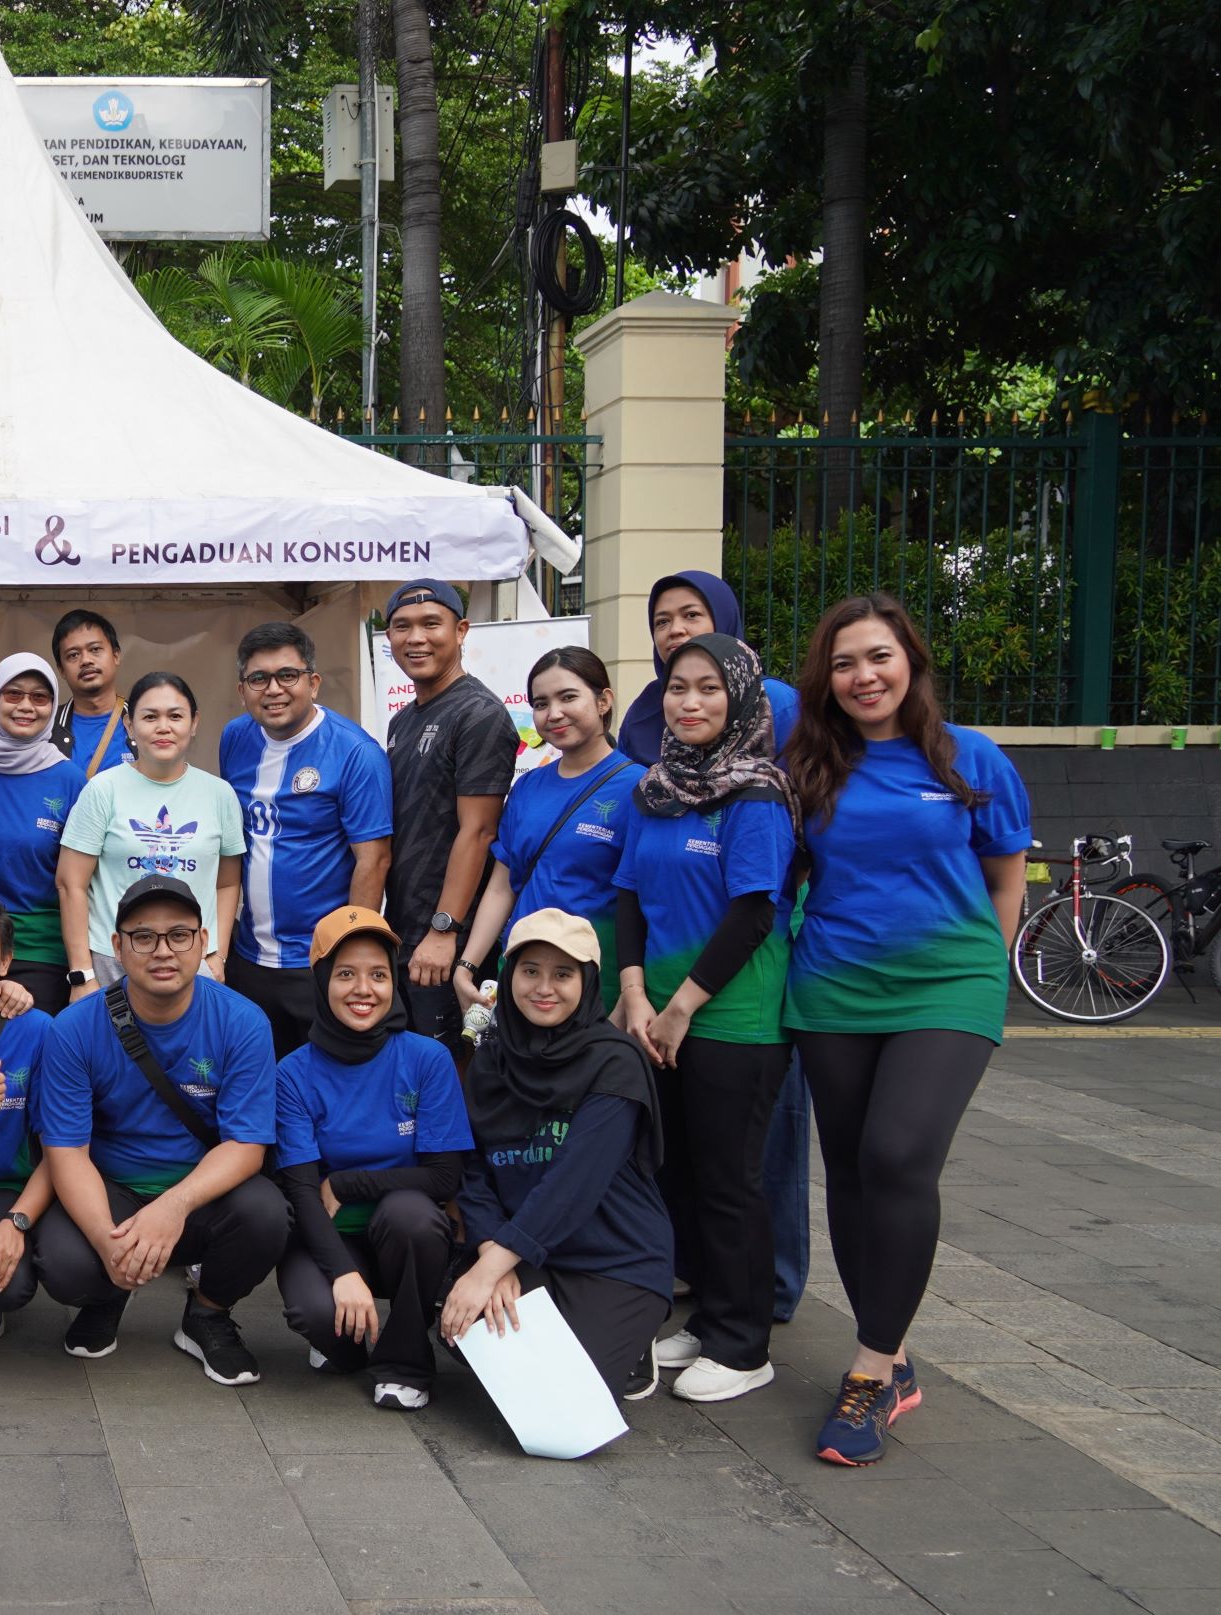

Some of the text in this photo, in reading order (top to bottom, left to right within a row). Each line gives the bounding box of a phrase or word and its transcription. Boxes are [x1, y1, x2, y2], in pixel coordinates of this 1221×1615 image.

[70, 138, 155, 152] PENDIDIKAN,
[159, 138, 247, 152] KEBUDAYAAN,
[82, 154, 109, 166] DAN
[112, 154, 186, 166] TEKNOLOGI
[70, 170, 183, 180] KEMENDIKBUDRISTEK
[111, 540, 431, 565] PENGADUAN KONSUMEN
[387, 684, 416, 696] AND
